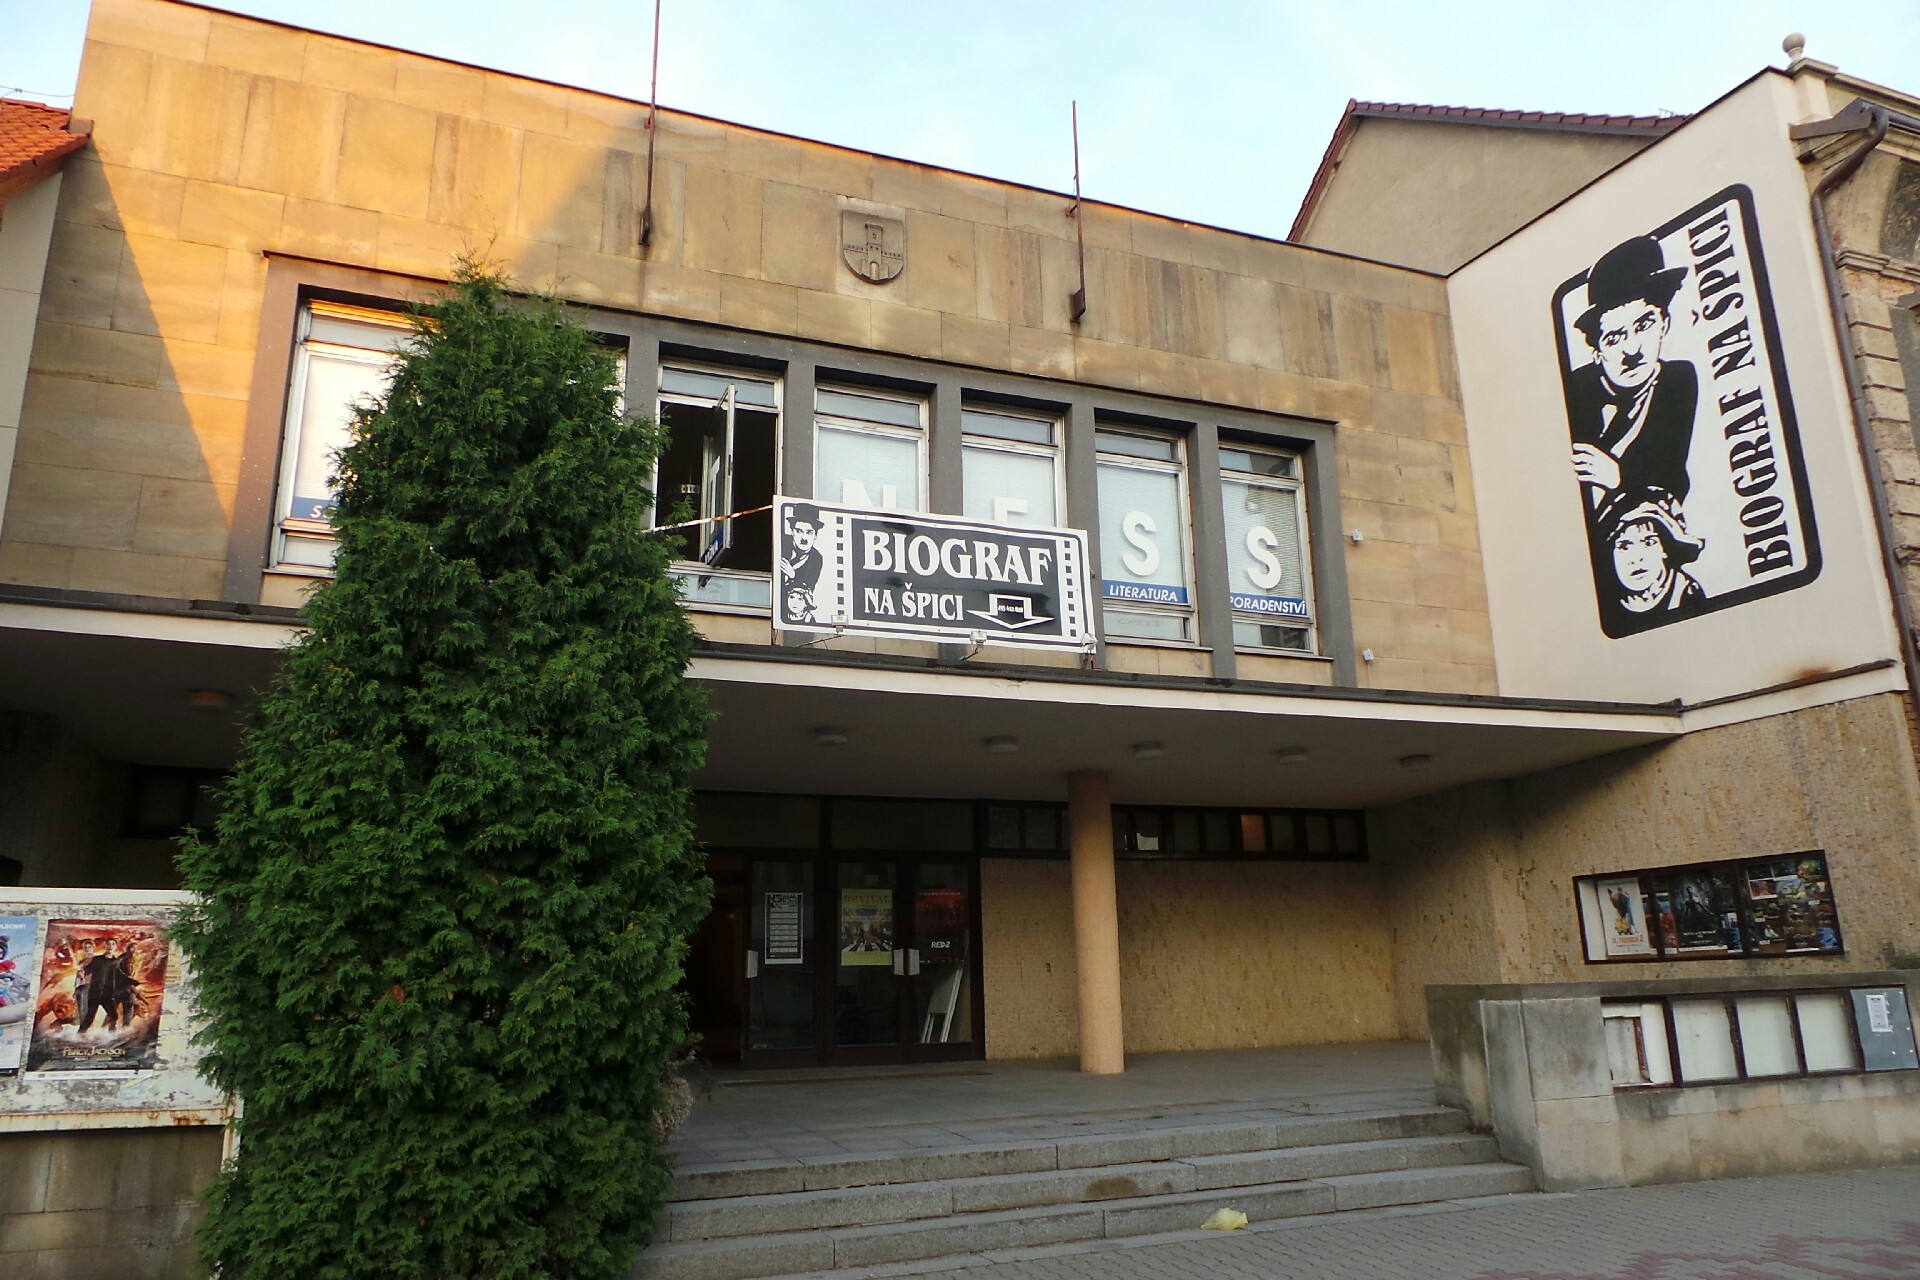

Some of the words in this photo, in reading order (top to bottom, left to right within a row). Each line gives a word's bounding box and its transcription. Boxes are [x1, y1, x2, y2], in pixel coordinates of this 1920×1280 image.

[1688, 207, 1745, 327] ŠPICI
[1707, 315, 1756, 381] NA
[1718, 385, 1794, 578] BIOGRAF
[862, 530, 1053, 586] BIOGRAF
[863, 587, 897, 616] NA
[902, 582, 964, 621] ŠPICI
[1109, 584, 1178, 602] LITERATURA
